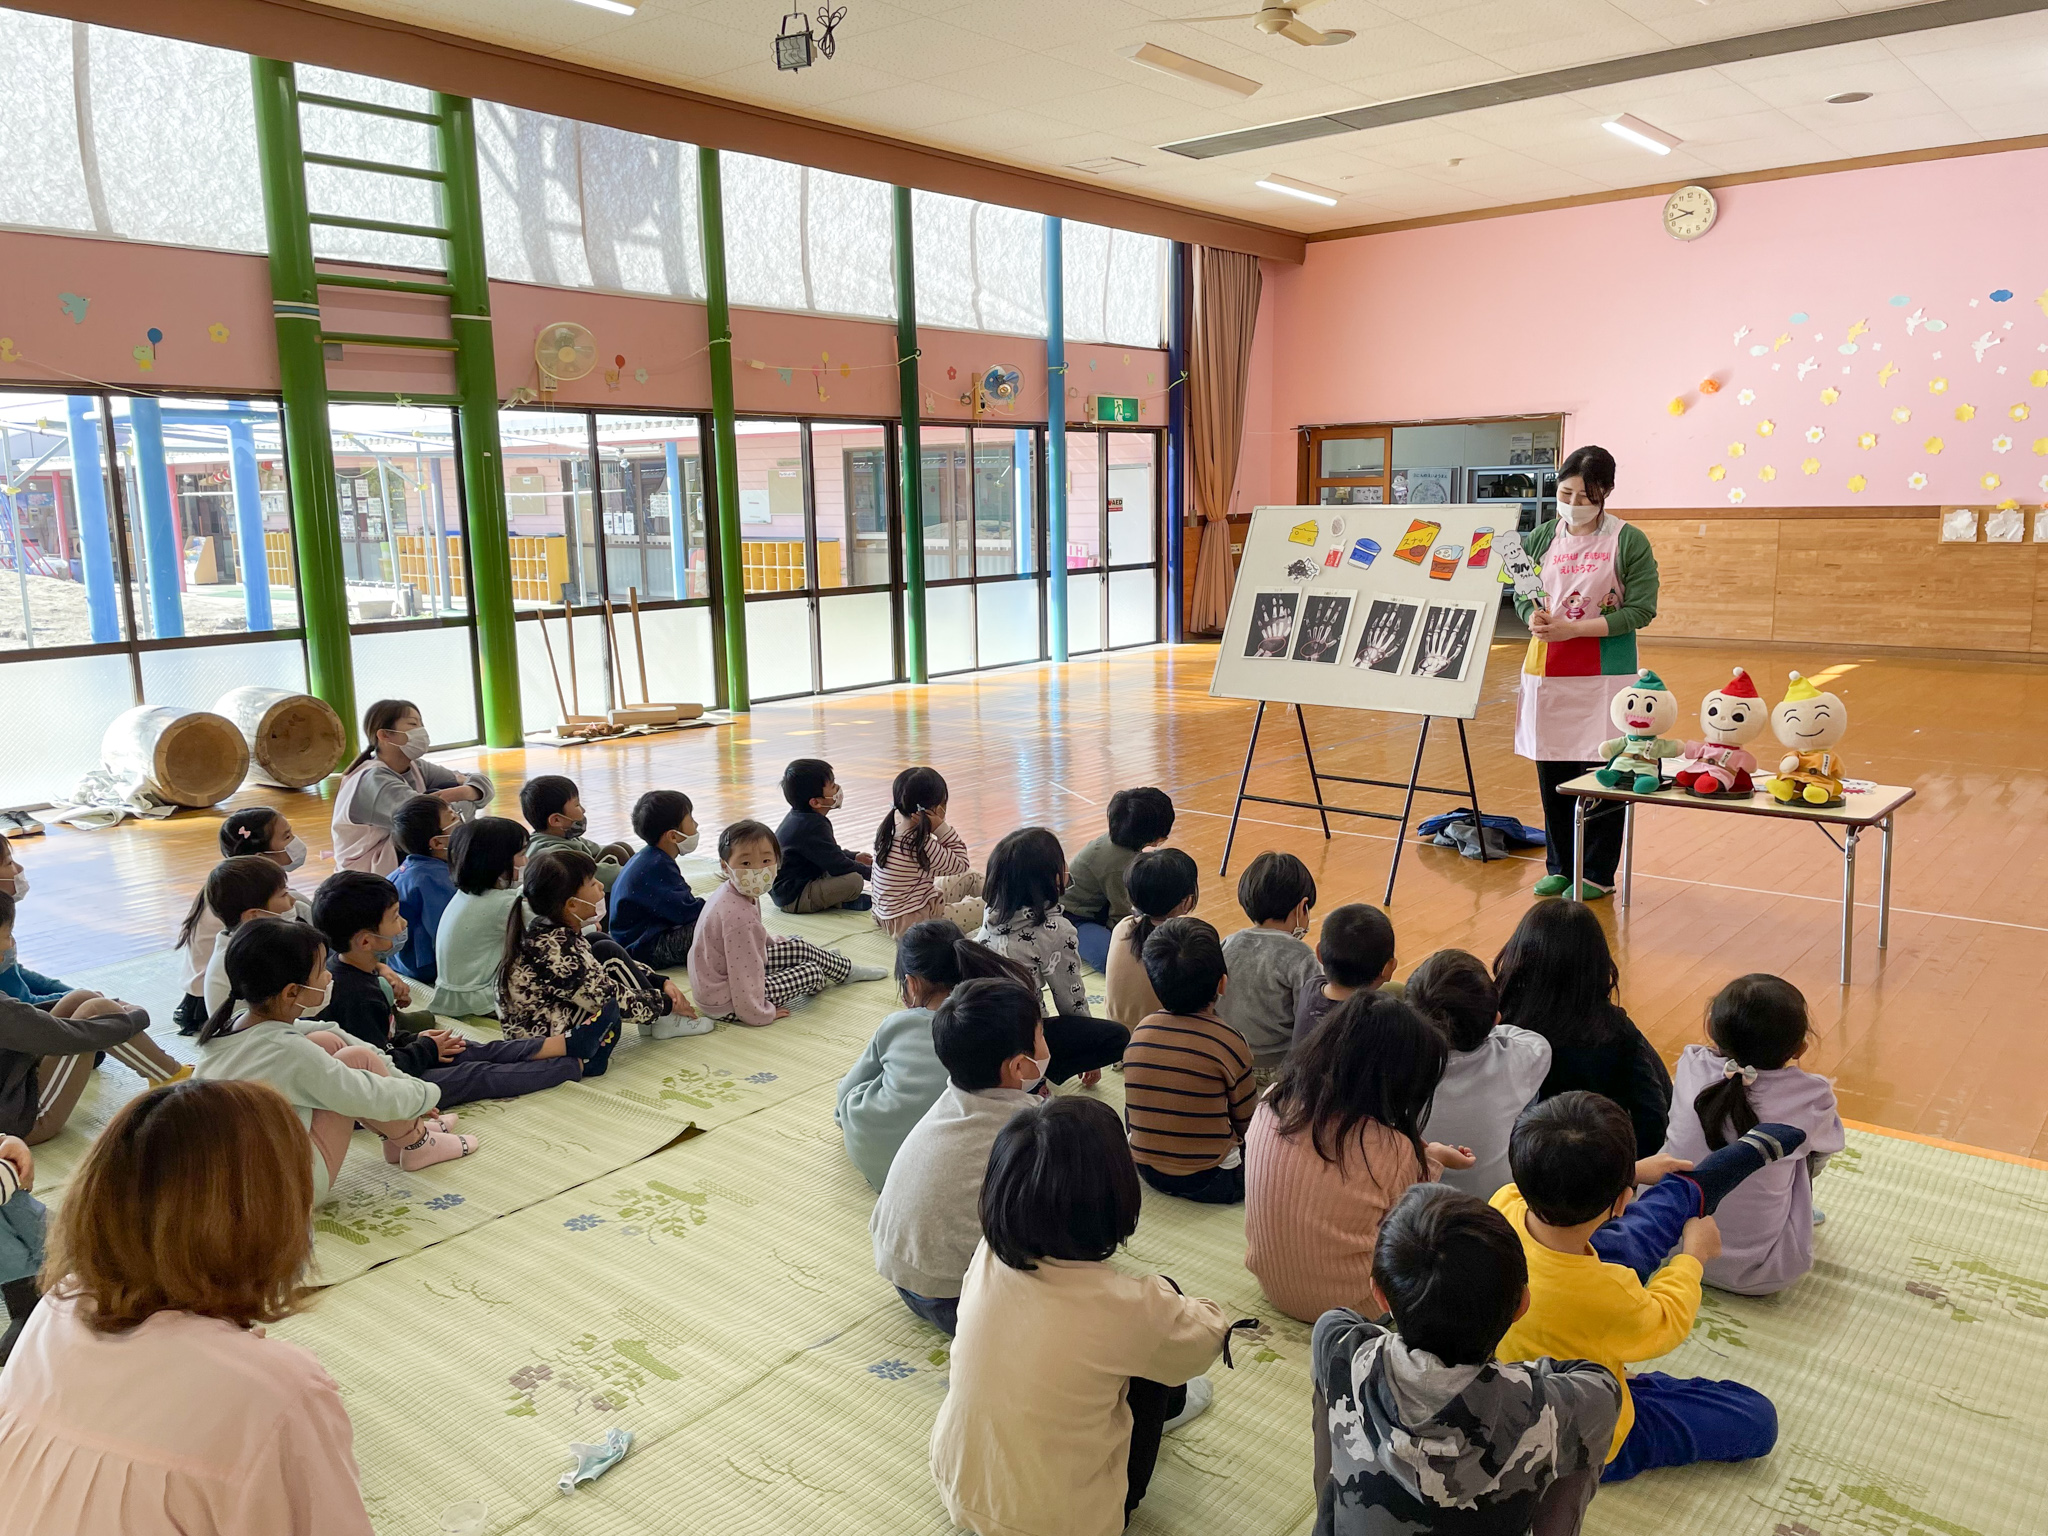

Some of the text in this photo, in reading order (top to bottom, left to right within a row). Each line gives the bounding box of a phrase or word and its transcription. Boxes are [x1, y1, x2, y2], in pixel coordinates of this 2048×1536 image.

[1402, 532, 1433, 546] スナック
[1511, 563, 1530, 574] カル
